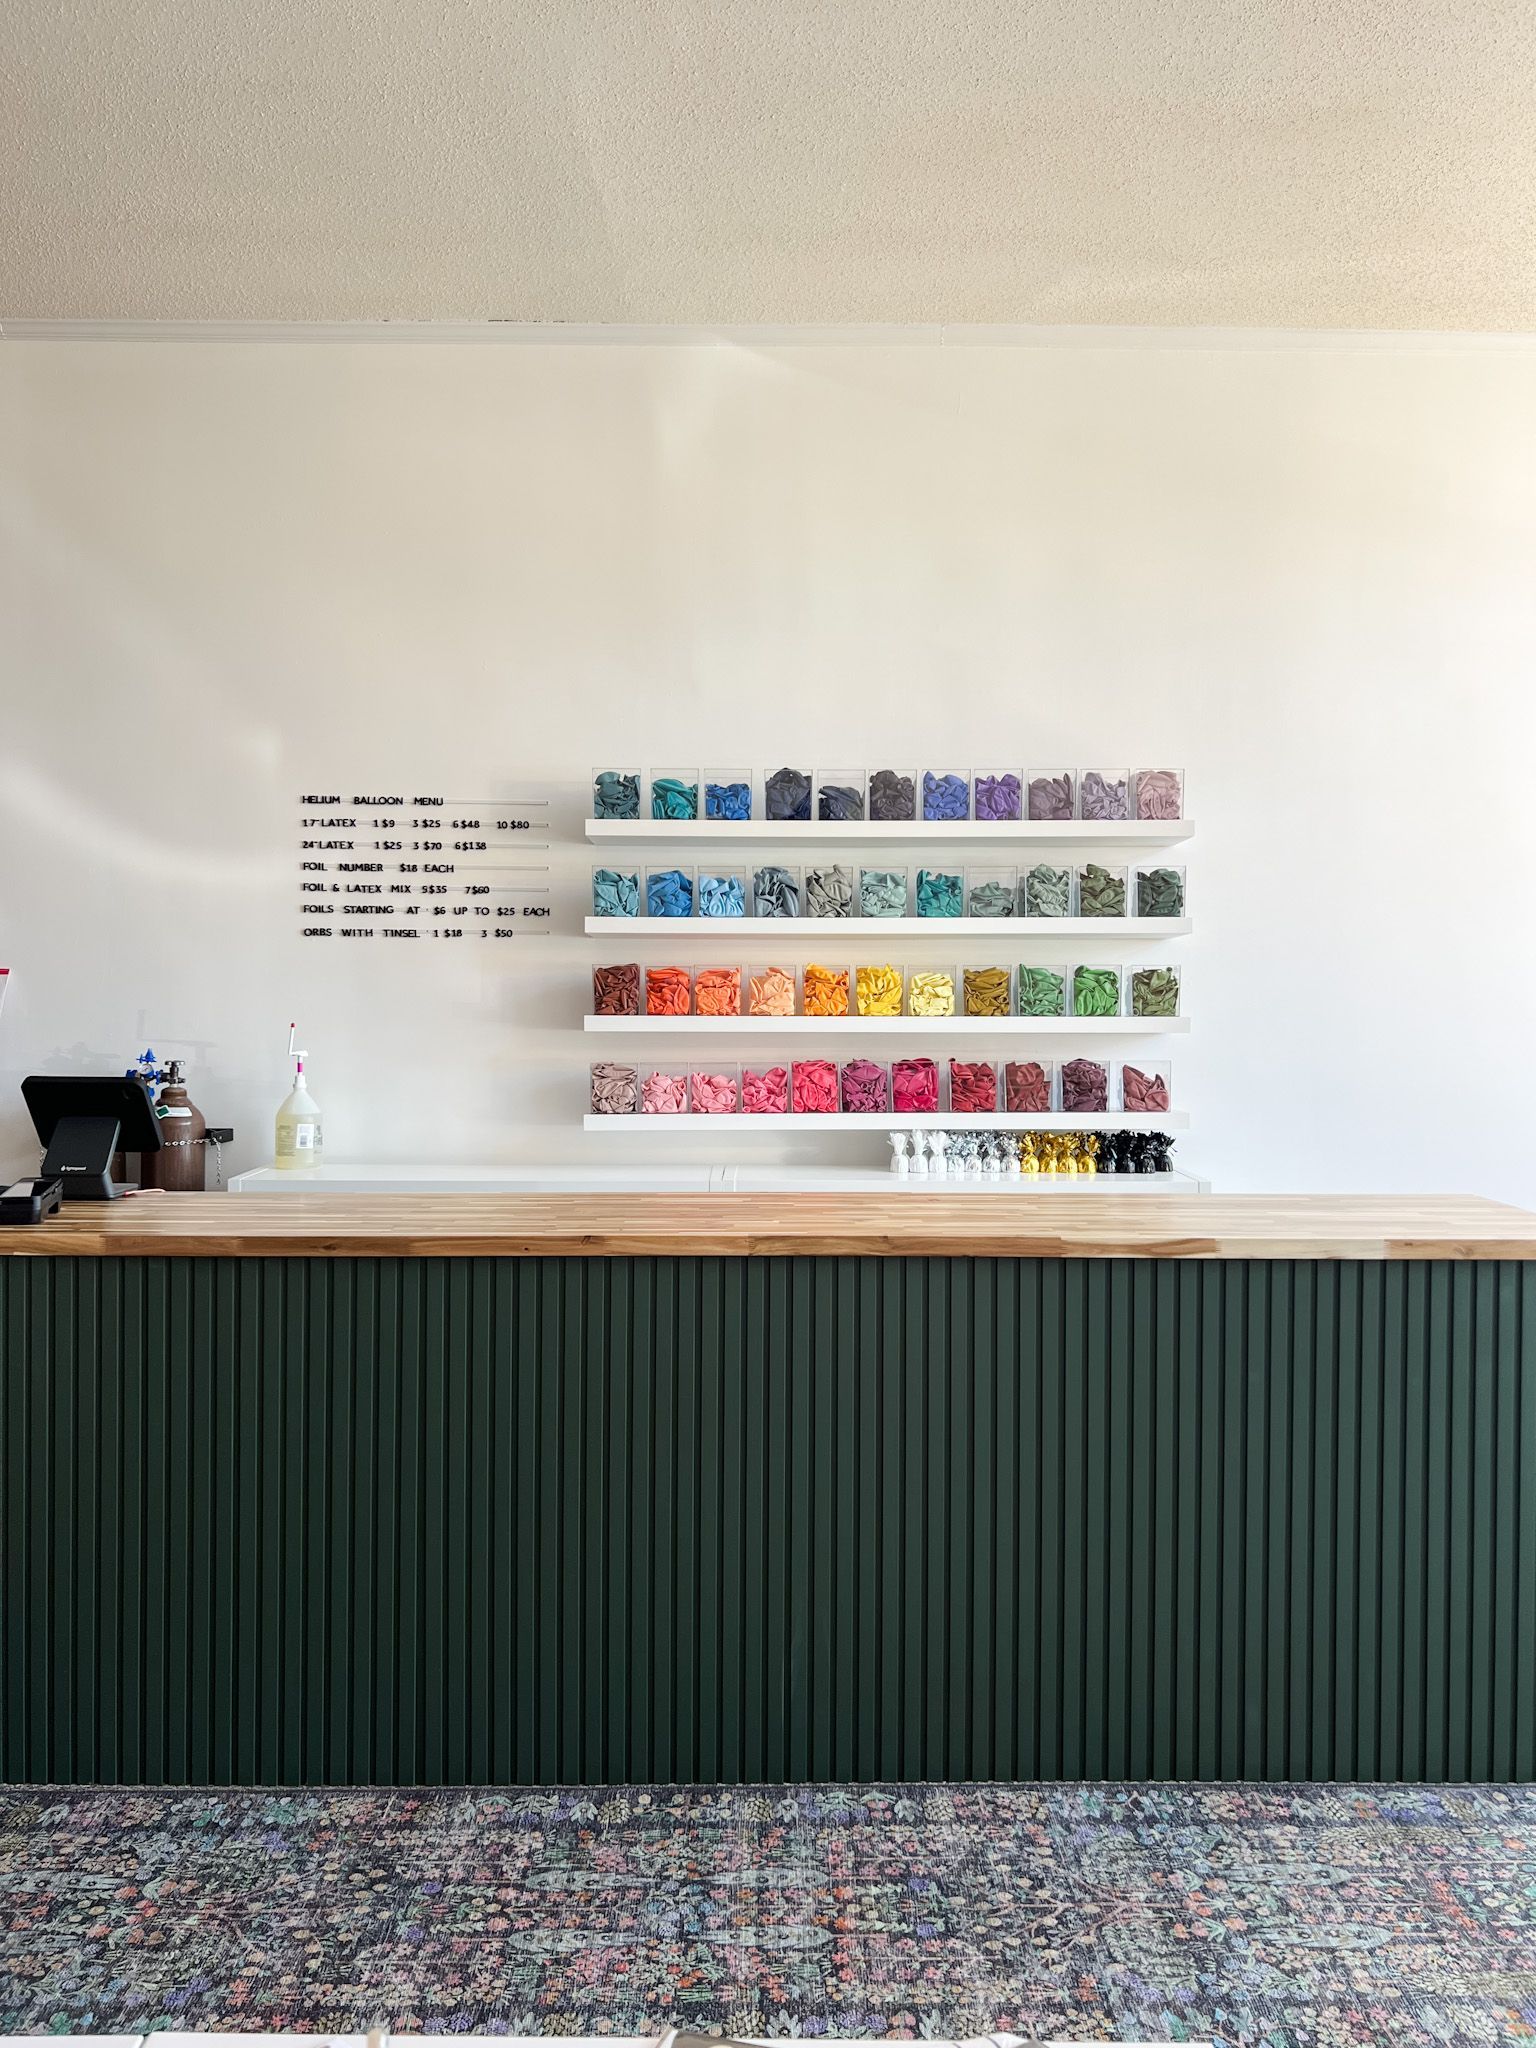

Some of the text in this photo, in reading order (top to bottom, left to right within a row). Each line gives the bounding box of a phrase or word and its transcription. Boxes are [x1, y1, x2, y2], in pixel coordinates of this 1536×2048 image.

[302, 795, 444, 806] HELIUM BALLOON MENU
[321, 818, 357, 828] LATEX
[382, 818, 396, 829] $9
[422, 818, 441, 829] $25
[496, 820, 509, 830] 10
[510, 819, 530, 830] $80
[319, 840, 355, 851] LATEX
[383, 840, 402, 851] $25
[423, 841, 443, 851] $70
[302, 862, 455, 874] FOIL NUMBER $18 EACH
[302, 882, 328, 893] FOIL
[346, 884, 382, 894] LATEX
[390, 884, 412, 894] MIX
[303, 904, 551, 917] FOILS STARTING AT $6 UP TO $25 EACH
[303, 927, 333, 937] ORBS
[341, 928, 374, 938] WITH
[383, 928, 421, 939] TINSEL
[444, 928, 463, 939] $18
[494, 928, 513, 939] $50
